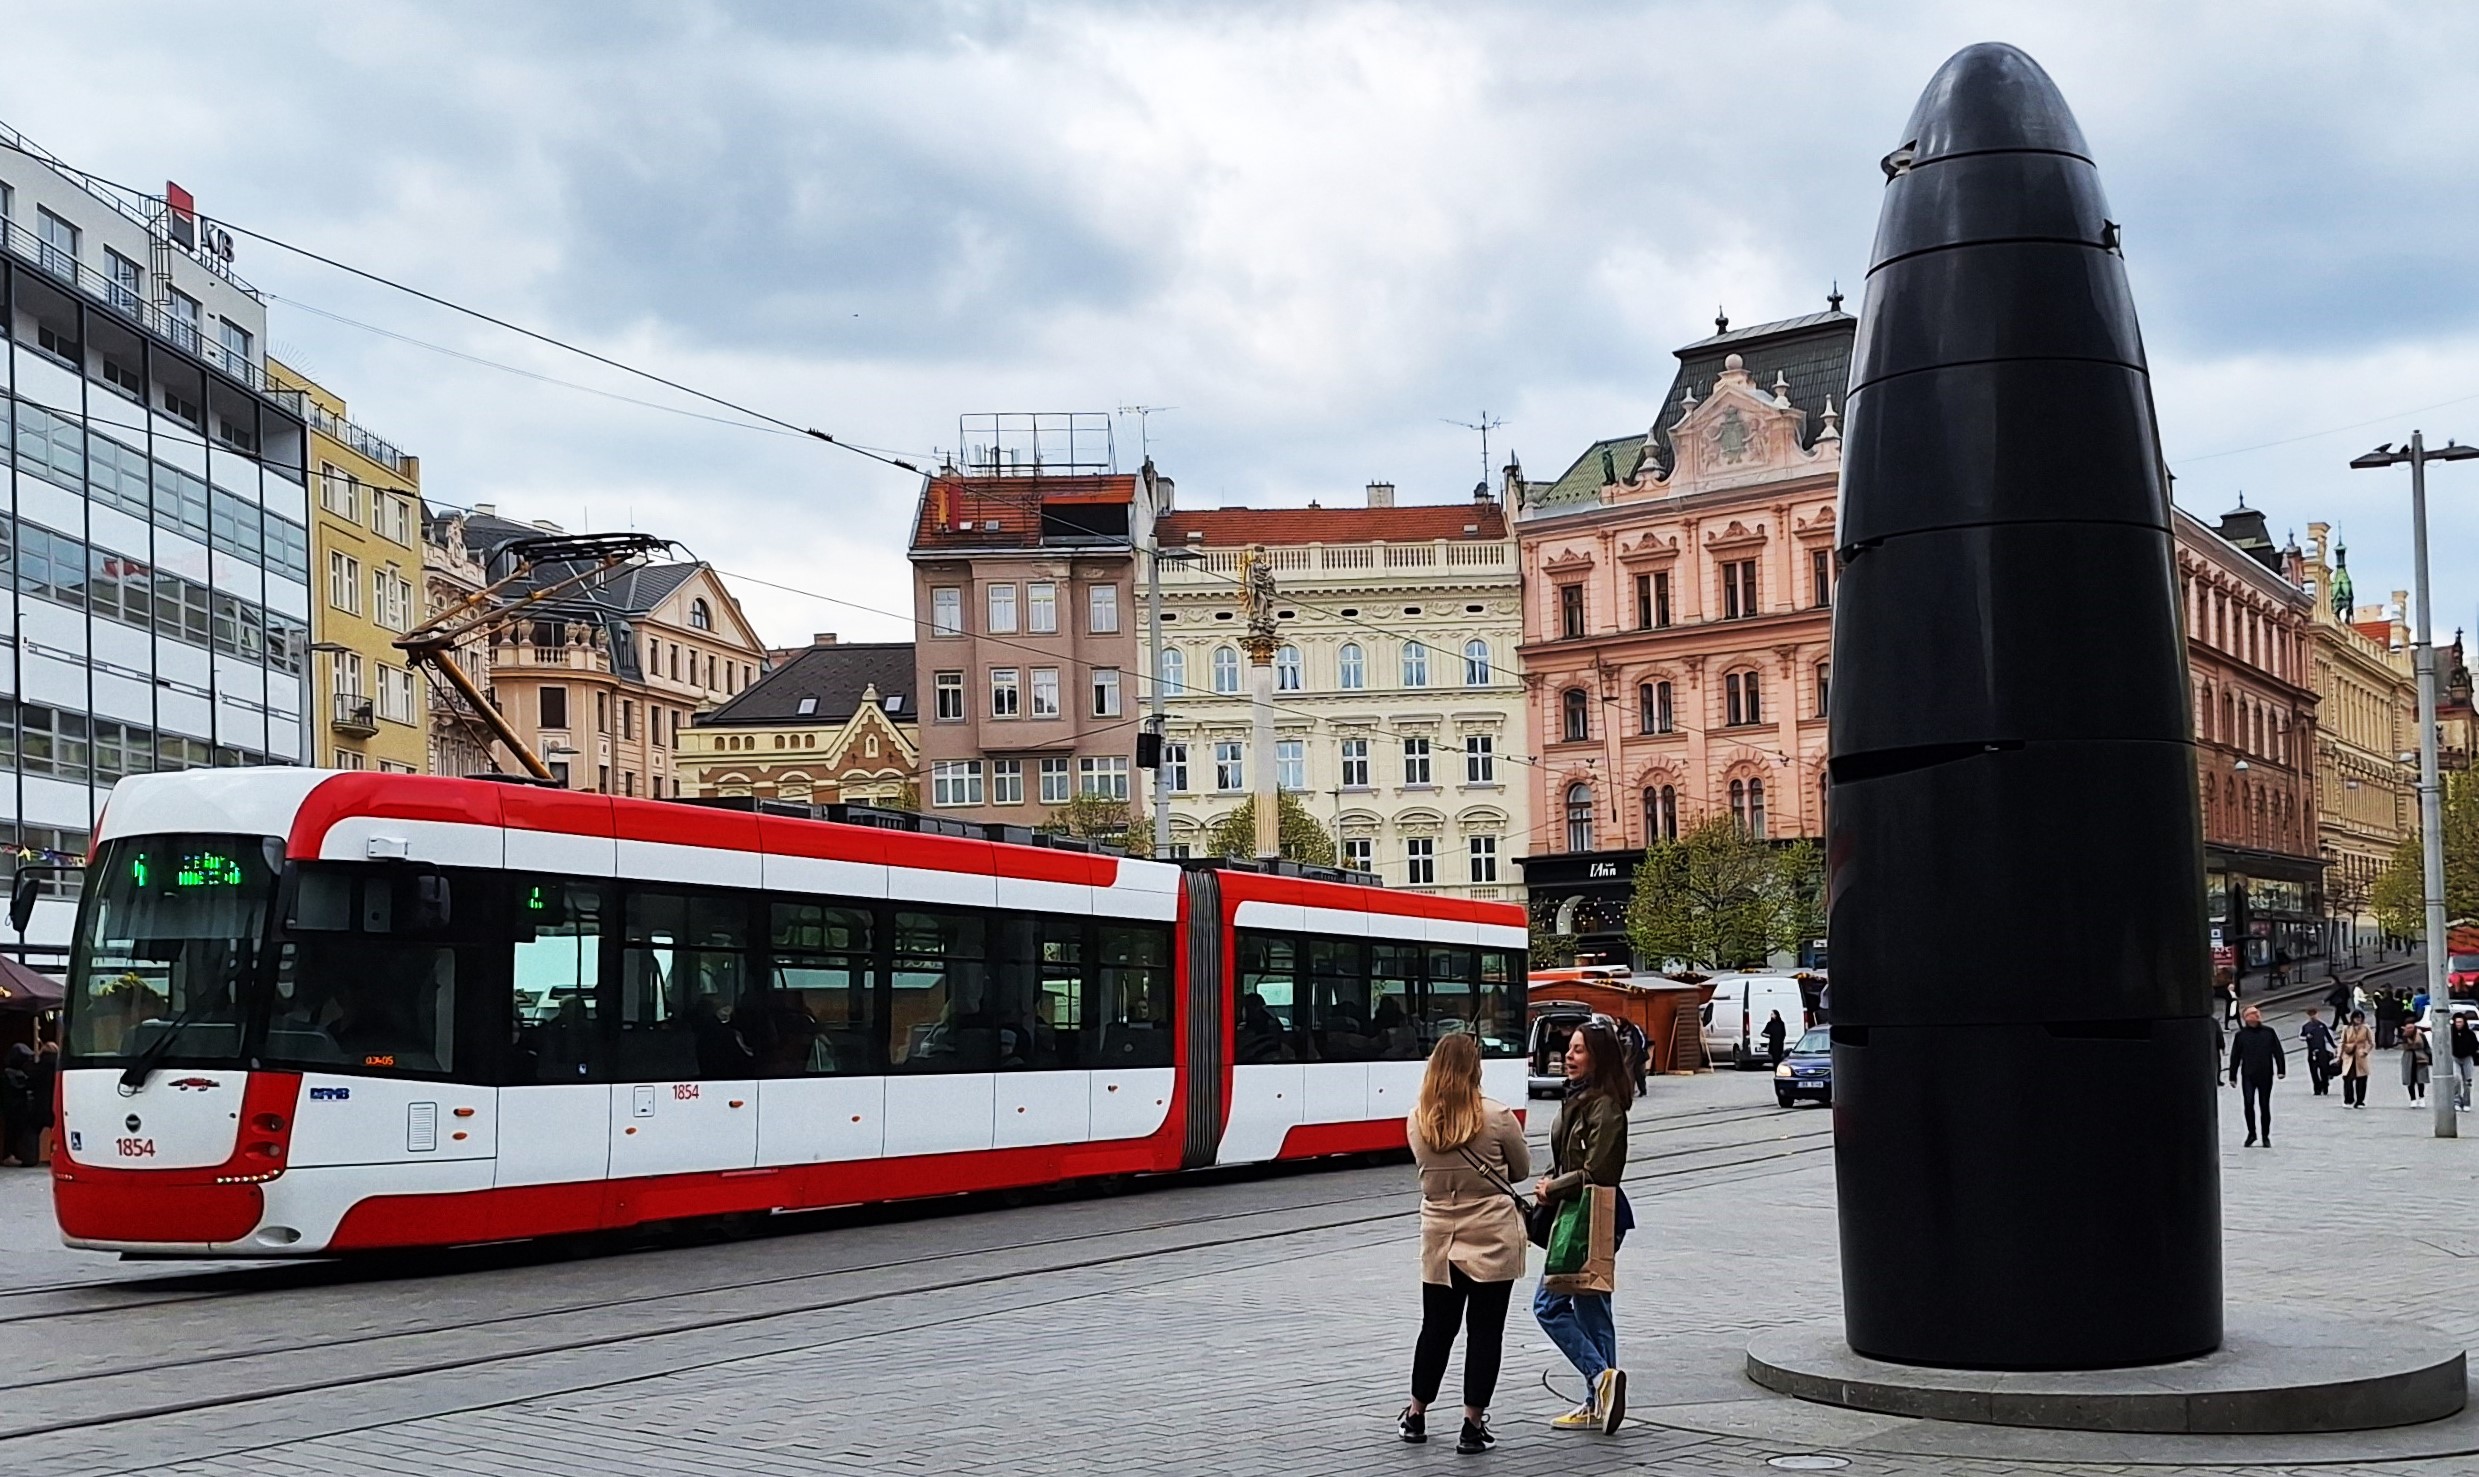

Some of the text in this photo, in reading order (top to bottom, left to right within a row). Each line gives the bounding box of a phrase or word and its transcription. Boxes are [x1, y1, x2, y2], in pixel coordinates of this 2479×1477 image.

[201, 217, 235, 263] KB
[672, 1084, 699, 1100] 1854
[115, 1138, 156, 1157] 1854
